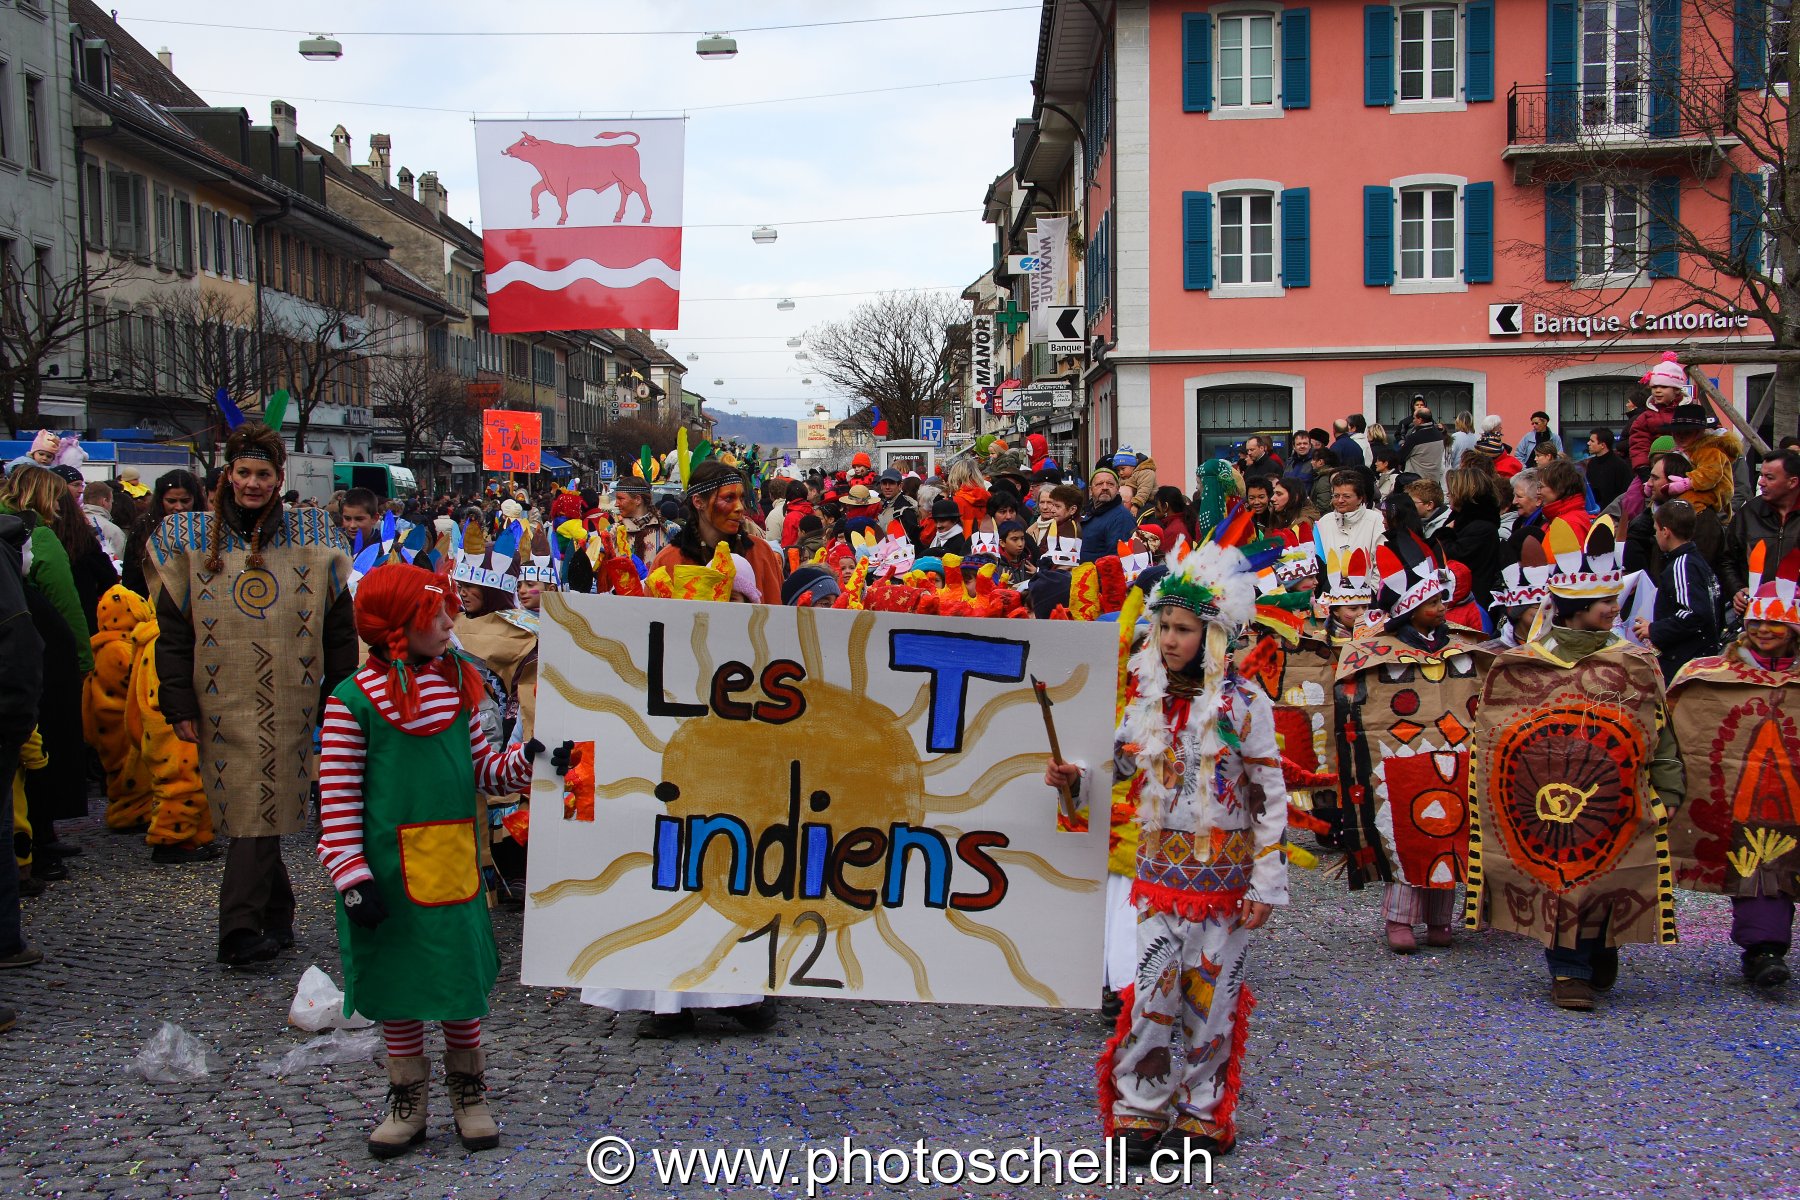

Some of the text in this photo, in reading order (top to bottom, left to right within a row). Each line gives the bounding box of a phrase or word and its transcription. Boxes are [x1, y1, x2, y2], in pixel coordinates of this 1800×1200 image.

[1533, 306, 1750, 338] Banque Cantonale
[976, 318, 991, 386] MANOR
[1051, 343, 1082, 353] Banque
[486, 413, 505, 427] Les
[923, 420, 934, 435] P
[485, 444, 497, 456] de
[502, 453, 536, 472] Bulle
[647, 621, 1030, 753] Les T
[652, 760, 1010, 912] indiens
[737, 910, 845, 990] 12
